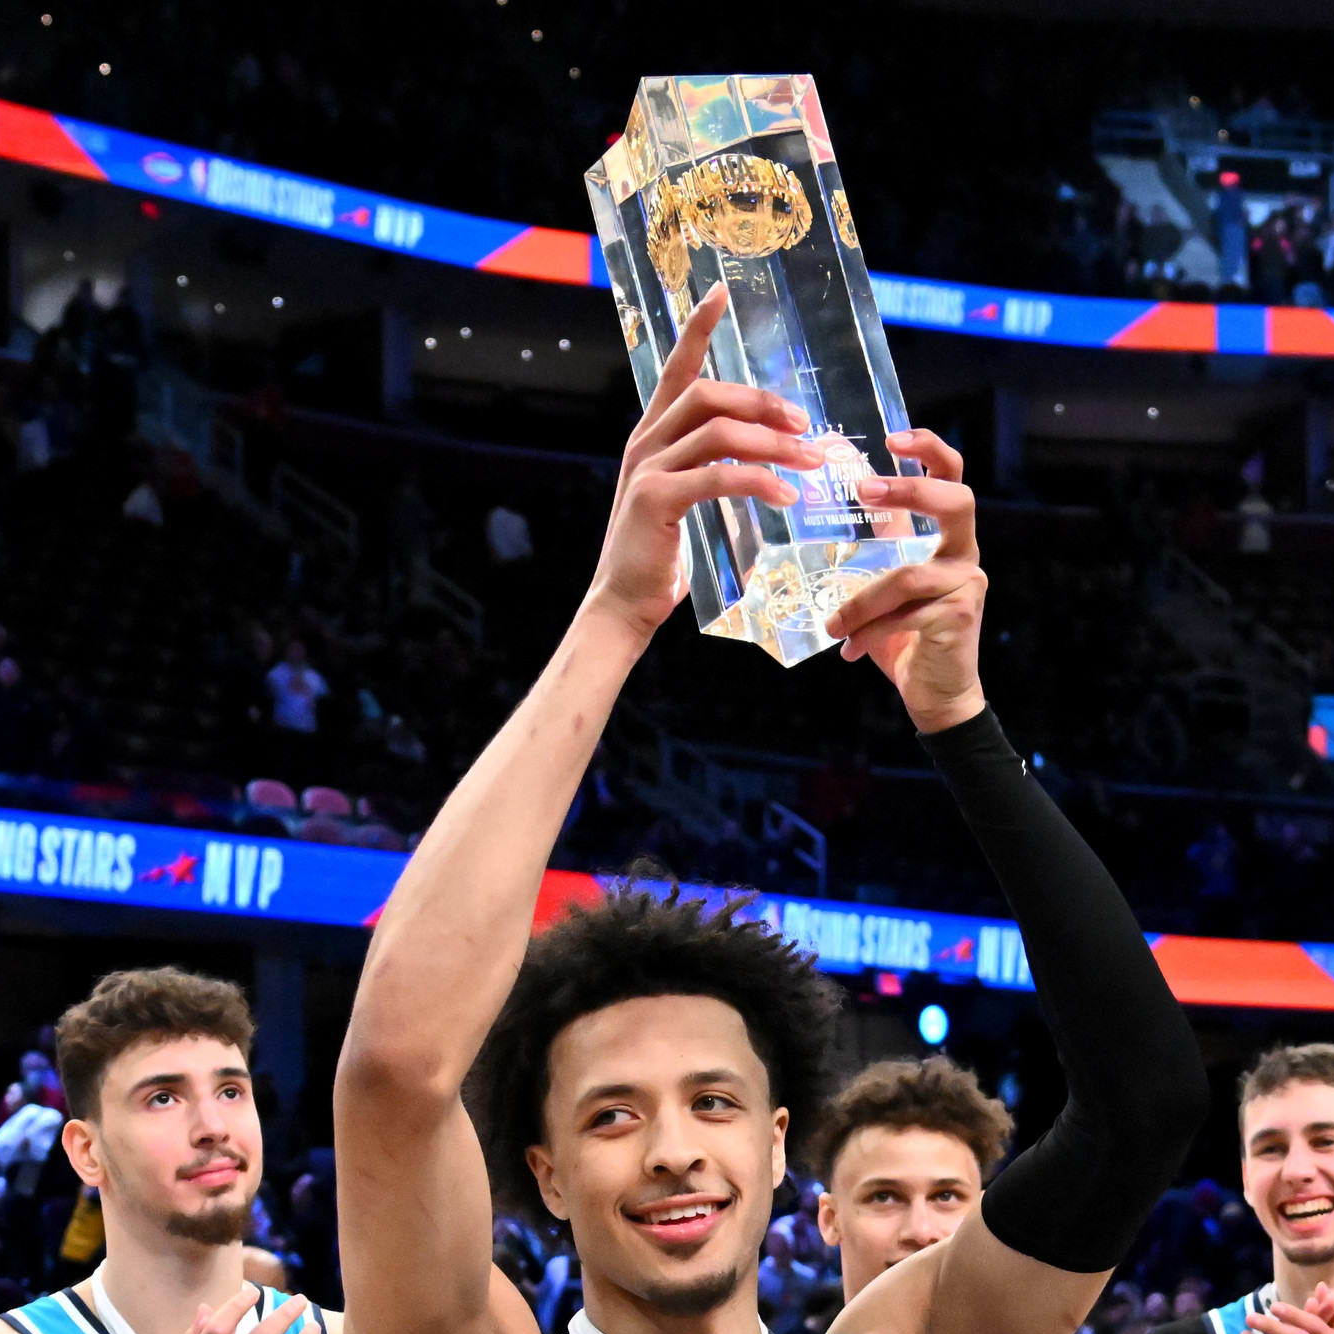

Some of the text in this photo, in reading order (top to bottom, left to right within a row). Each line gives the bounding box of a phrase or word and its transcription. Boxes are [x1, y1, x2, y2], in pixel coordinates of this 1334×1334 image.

[834, 481, 859, 502] STA
[827, 513, 864, 525] VALUABLE
[865, 511, 894, 523] PLAYER
[36, 822, 136, 892] STARS
[201, 840, 284, 911] MVP
[860, 913, 932, 970] STARS
